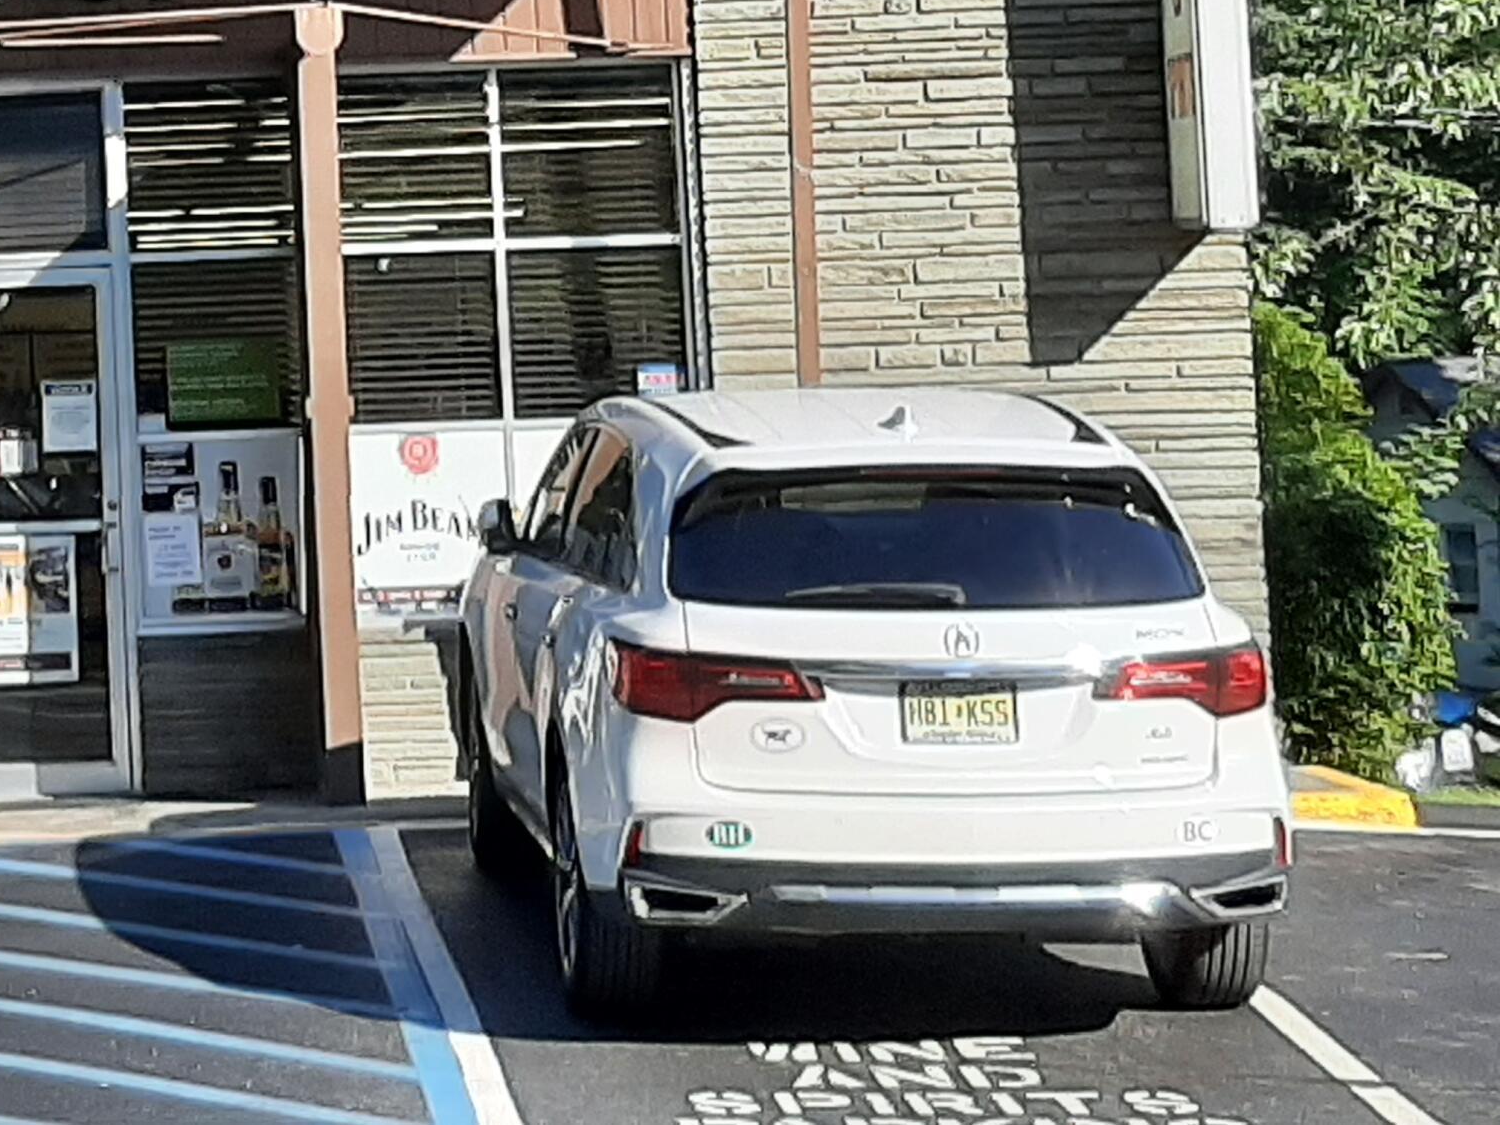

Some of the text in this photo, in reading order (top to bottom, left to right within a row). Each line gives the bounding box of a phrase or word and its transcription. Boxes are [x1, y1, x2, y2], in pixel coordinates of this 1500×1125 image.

[357, 509, 403, 557] JIM
[793, 1063, 1044, 1088] AND
[688, 1089, 1200, 1116] SPIRITS
